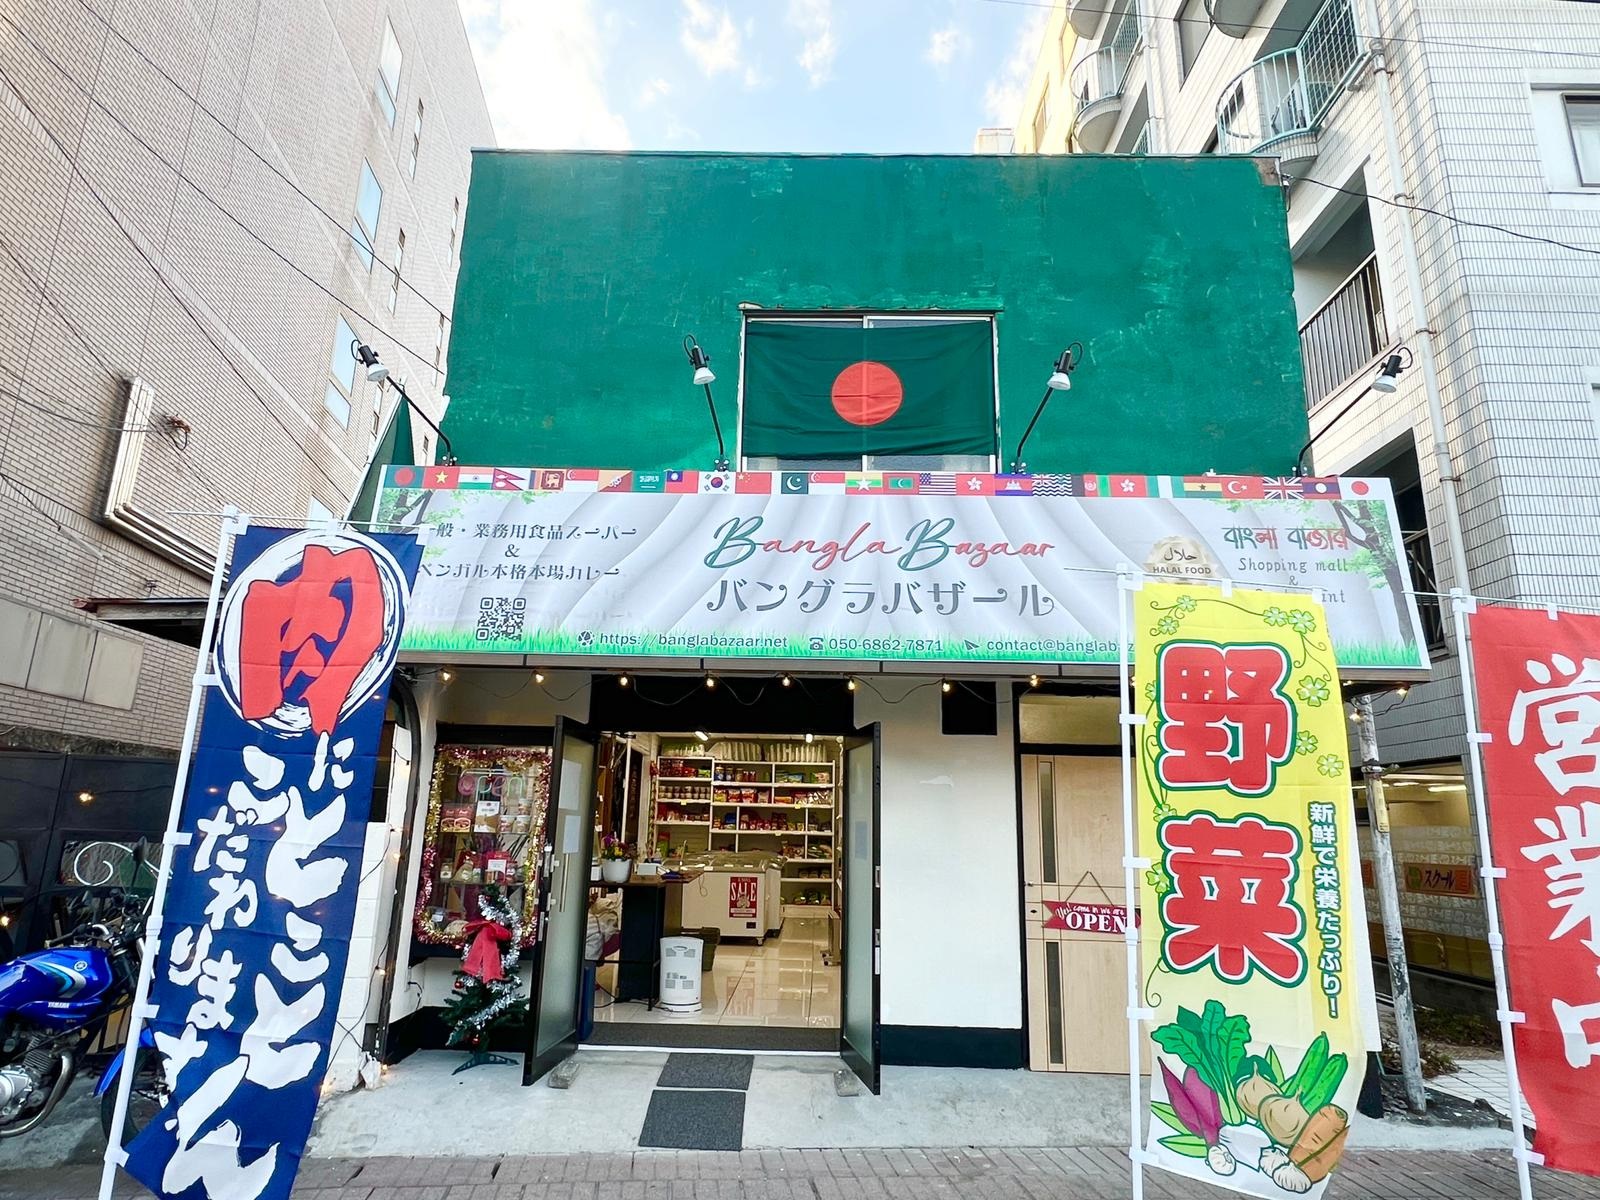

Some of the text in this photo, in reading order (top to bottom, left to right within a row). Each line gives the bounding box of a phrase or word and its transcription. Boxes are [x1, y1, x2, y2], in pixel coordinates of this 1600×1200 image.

[704, 515, 1054, 571] Bangla Bazaar
[1221, 523, 1350, 551] বাংলা বাজার
[504, 543, 520, 558] &
[1163, 547, 1198, 562] حلال
[418, 562, 620, 581] ベンガル本格本場カレー
[1153, 566, 1212, 575] HALAL FOOD
[1238, 557, 1349, 574] Shopping mall
[1289, 575, 1299, 586] &
[706, 578, 1055, 617] バングラバザール
[599, 633, 789, 648] https://banglabazaar.net
[829, 638, 944, 651] 050-6862-7871
[986, 639, 1135, 655] contact@banglabz
[1160, 643, 1306, 984] 野菜
[1424, 869, 1456, 890] スクール
[731, 882, 757, 902] SALE
[1055, 902, 1071, 920] Yes!
[1065, 911, 1127, 933] OPEN
